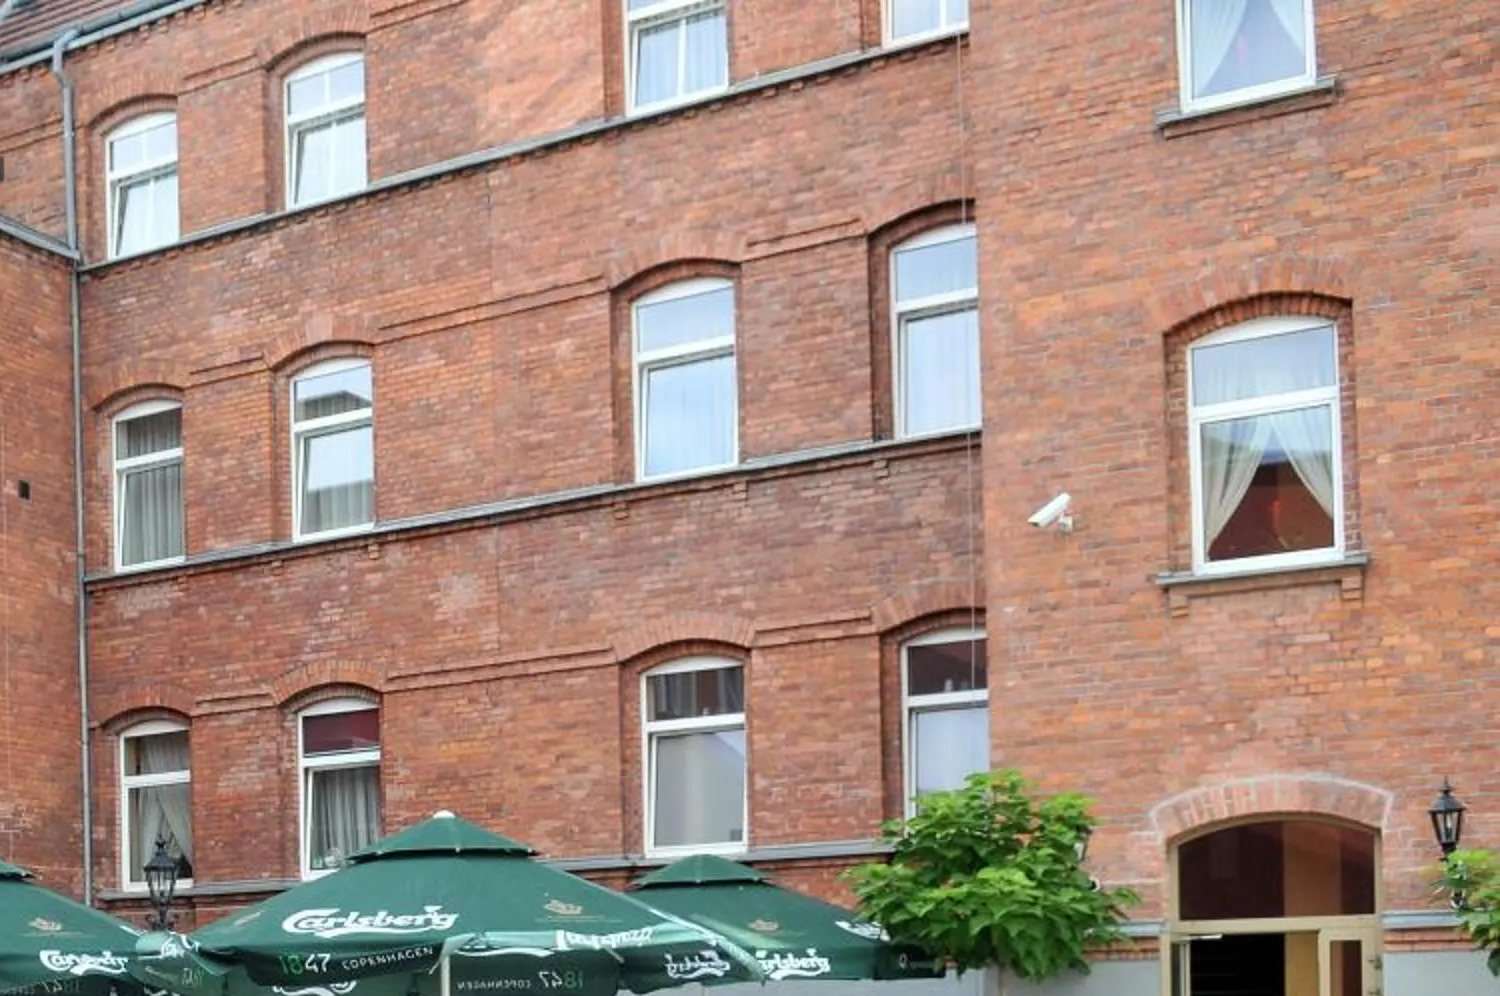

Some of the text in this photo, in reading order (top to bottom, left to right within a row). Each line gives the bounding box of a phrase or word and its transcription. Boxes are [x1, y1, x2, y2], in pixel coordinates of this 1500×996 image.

[281, 905, 459, 938] Carlsberg
[278, 946, 433, 975] 1847 COPENHAGEN
[755, 948, 831, 980] arlsberg
